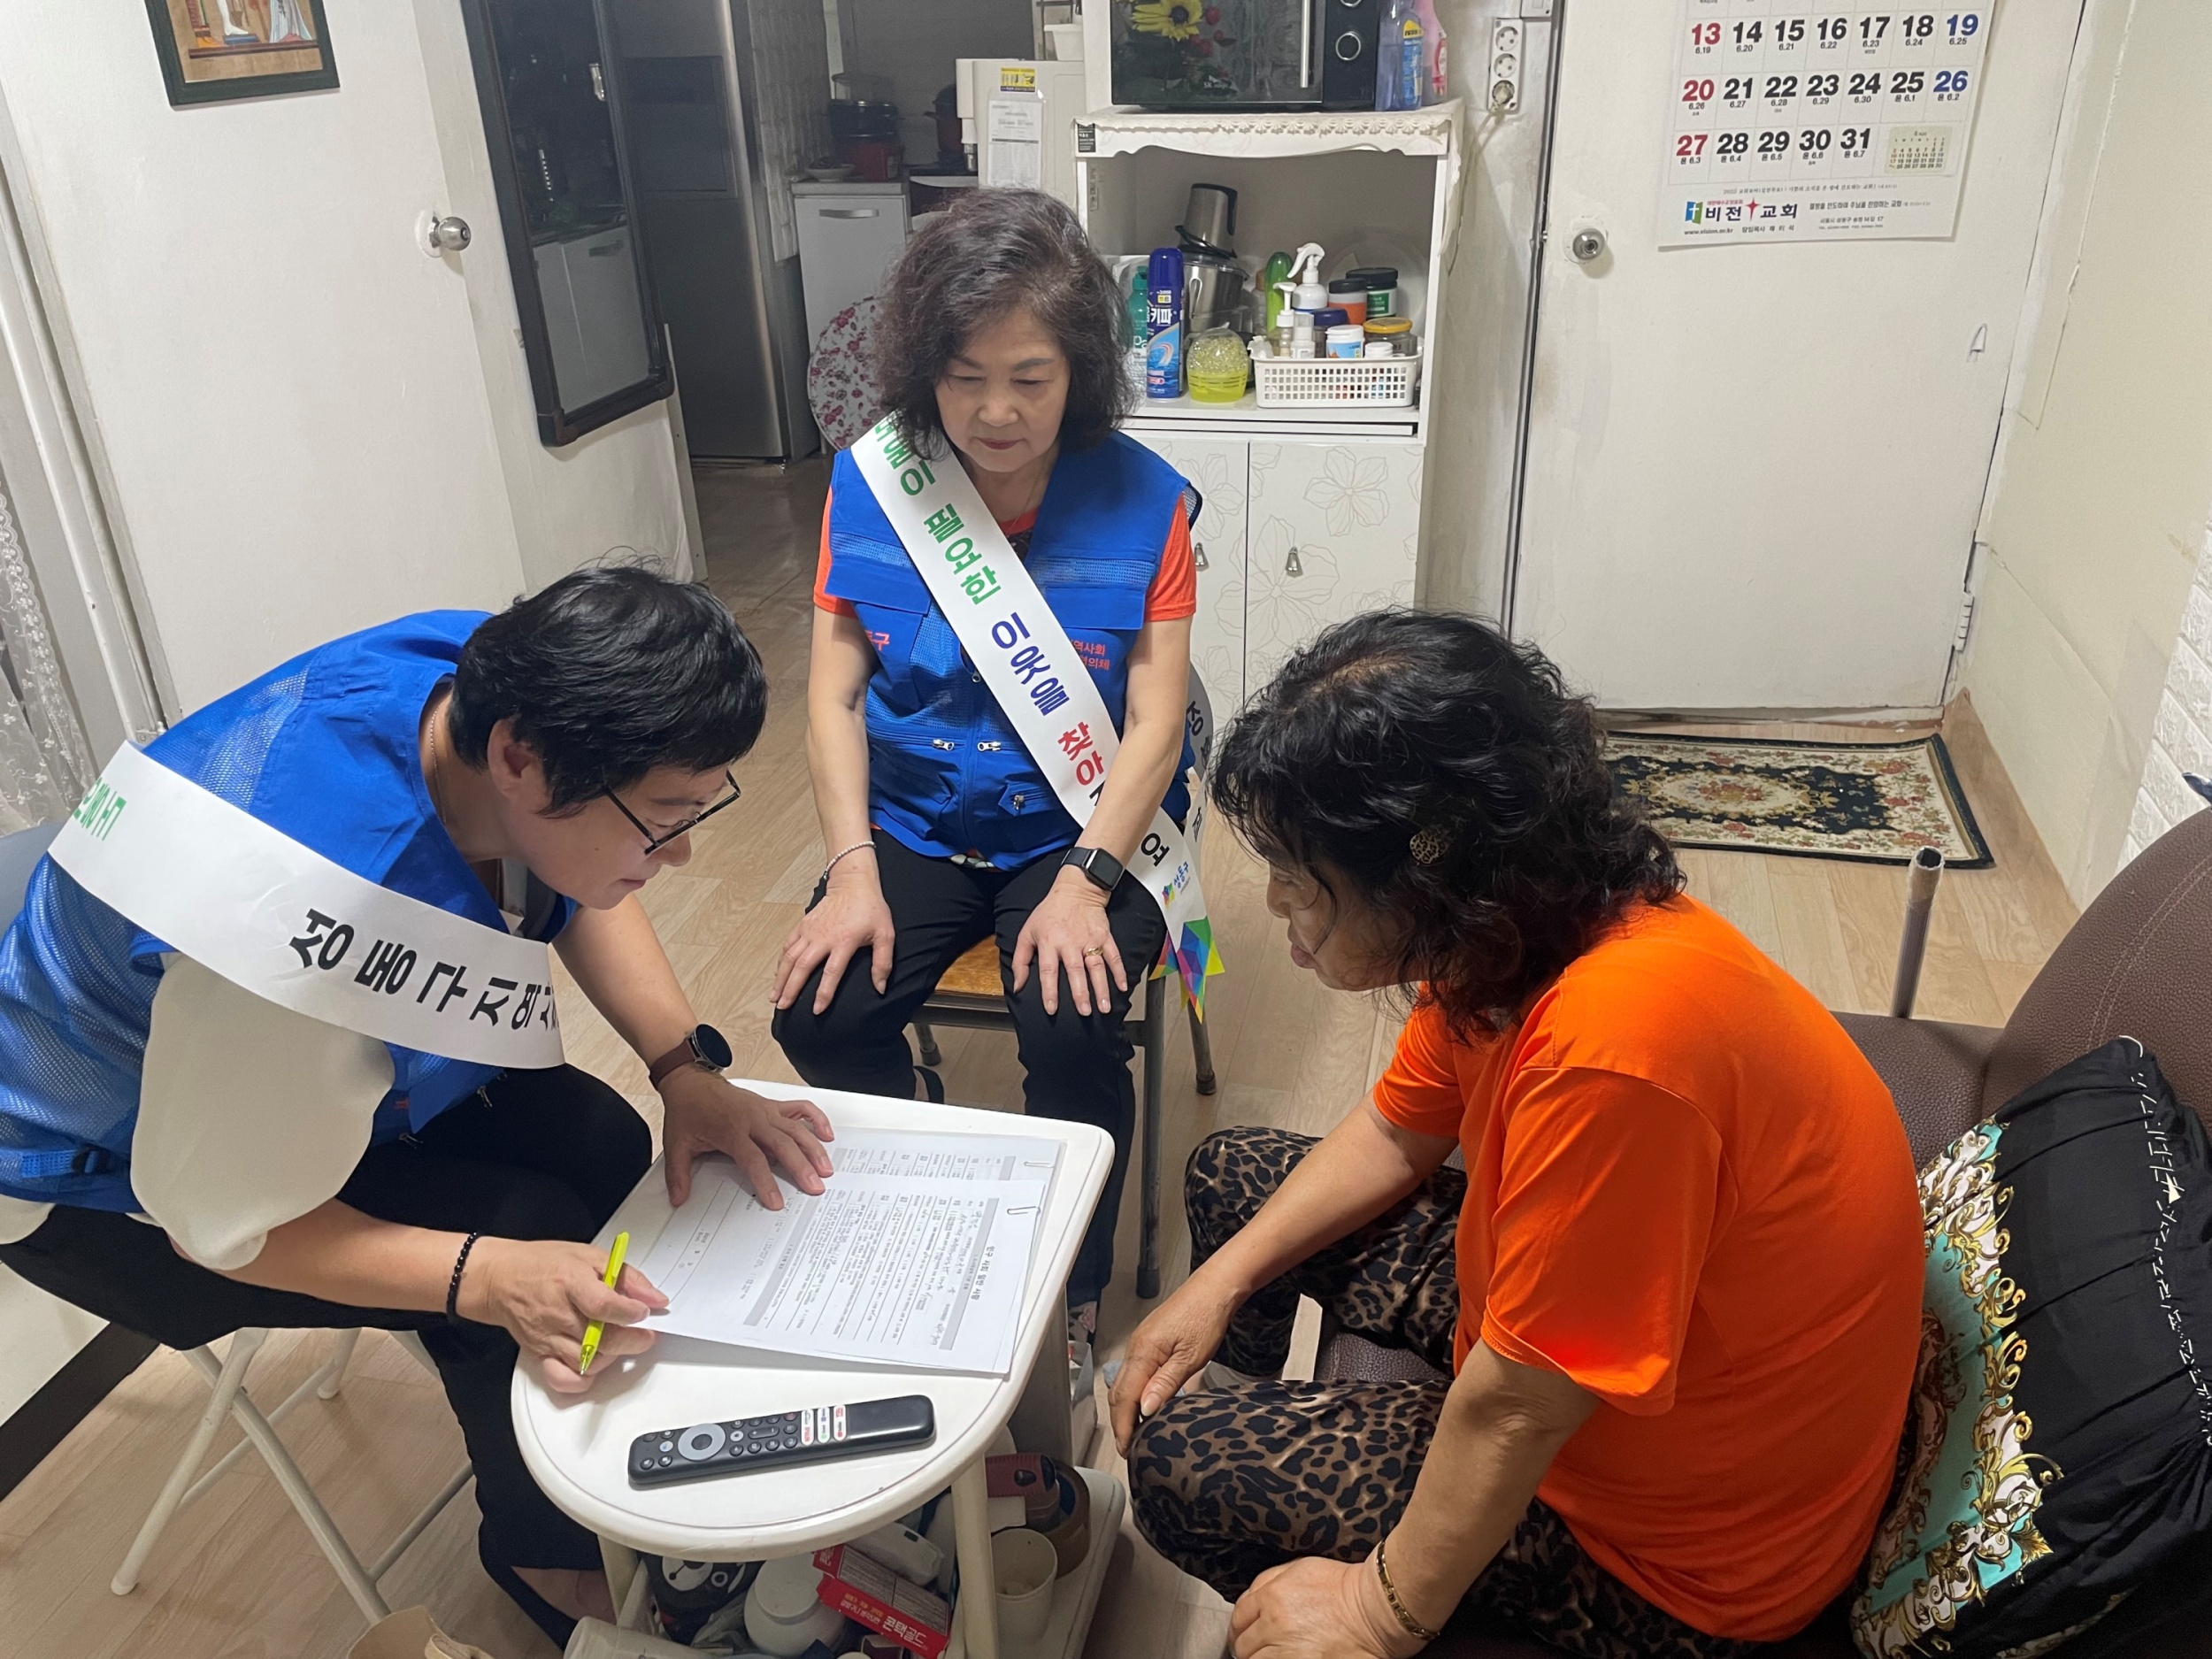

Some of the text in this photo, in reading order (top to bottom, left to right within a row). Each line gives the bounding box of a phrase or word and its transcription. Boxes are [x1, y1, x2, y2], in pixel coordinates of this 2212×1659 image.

[1692, 14, 1978, 45] 13 14 15 16 17 18 19
[1682, 70, 1969, 102] 20 21 22 23 24 25 26
[1677, 128, 1870, 156] 27 28 29 30 31
[1705, 204, 1798, 222] 비전 교회
[1148, 306, 1172, 325] 키파
[923, 503, 1002, 605] 필요한
[991, 611, 1070, 717] 이웃을
[1071, 640, 1105, 657] 역사회
[882, 1616, 927, 1647] 콘택골드
